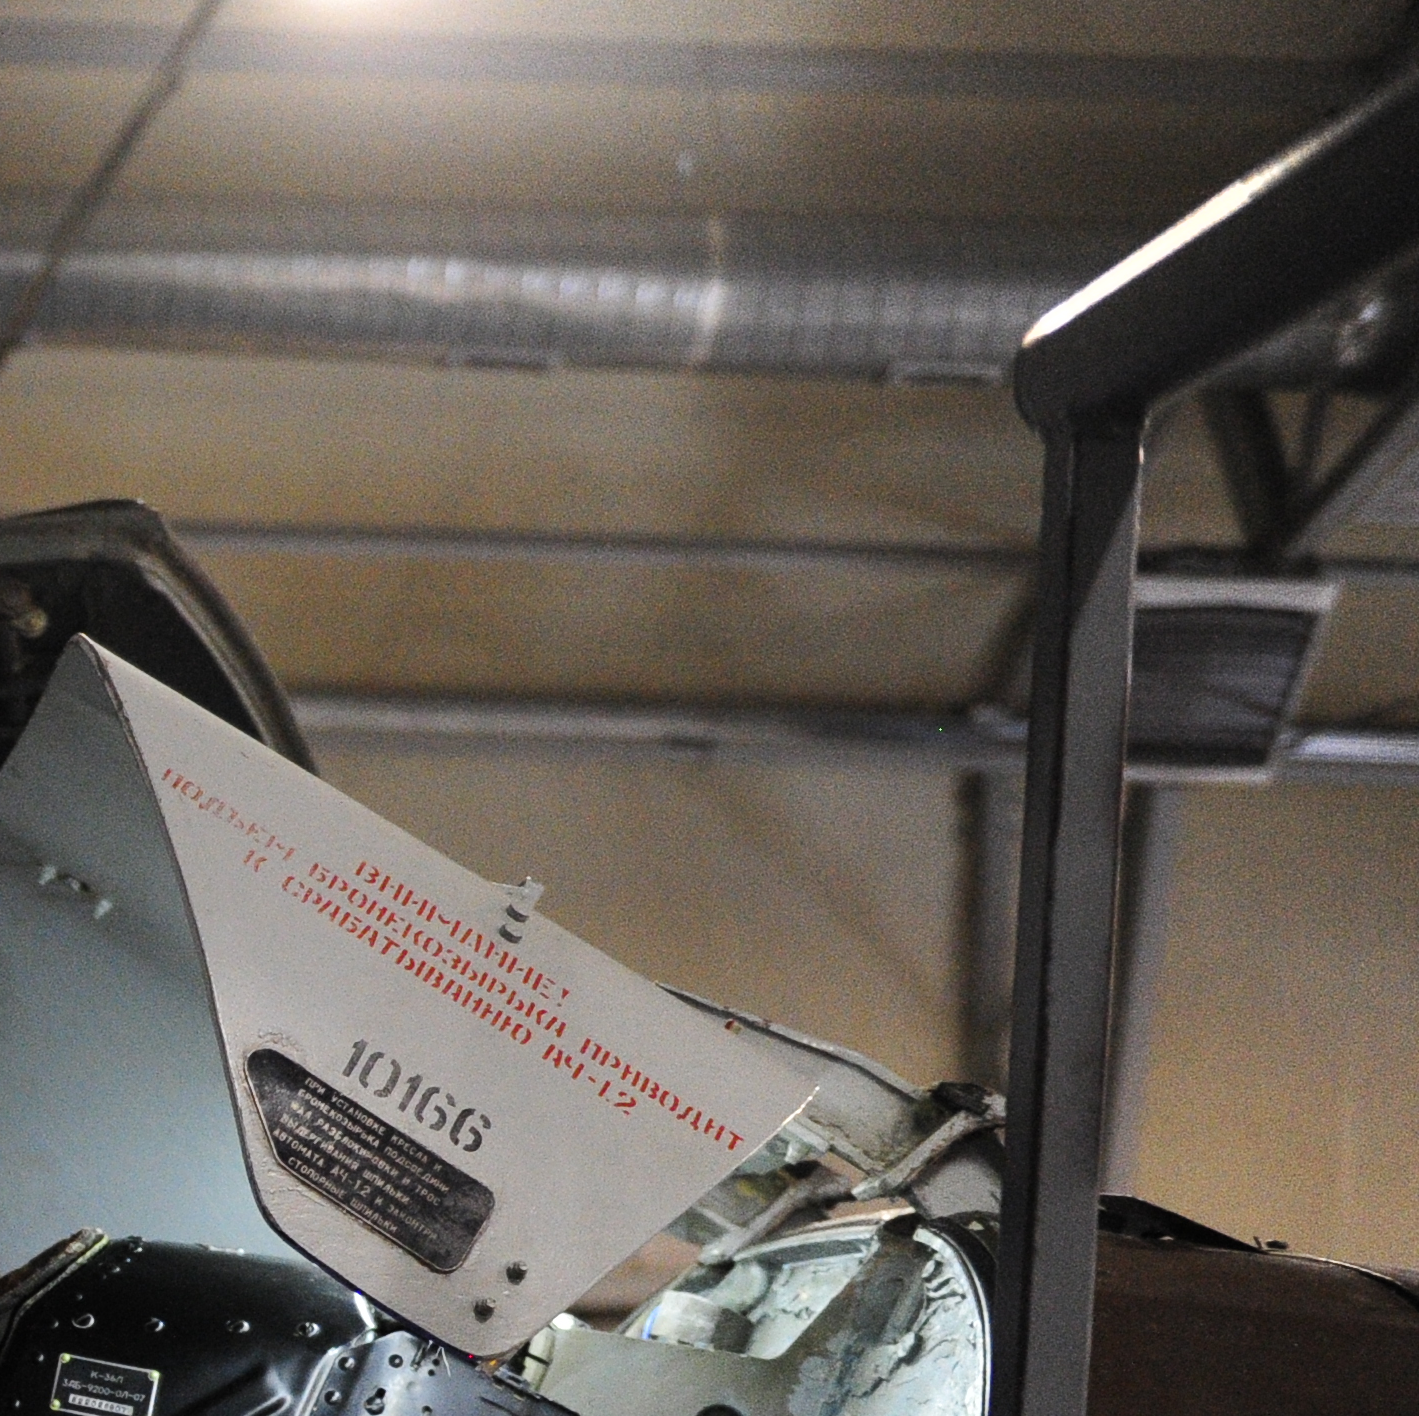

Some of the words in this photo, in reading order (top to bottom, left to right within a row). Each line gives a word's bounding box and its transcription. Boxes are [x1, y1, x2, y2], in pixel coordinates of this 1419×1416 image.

[241, 848, 267, 874] К
[353, 859, 570, 1007] ВНИМАНИЕ!
[303, 1076, 326, 1095] ПРИ
[329, 1094, 387, 1136] УСТАНОВКЕ
[389, 1134, 430, 1164] КРЕСЛА
[342, 1039, 491, 1153] 10166
[578, 1037, 744, 1153] ПРИВОДИТ
[271, 1127, 326, 1167] АВТОМАТА
[413, 1184, 441, 1206] ТРОС
